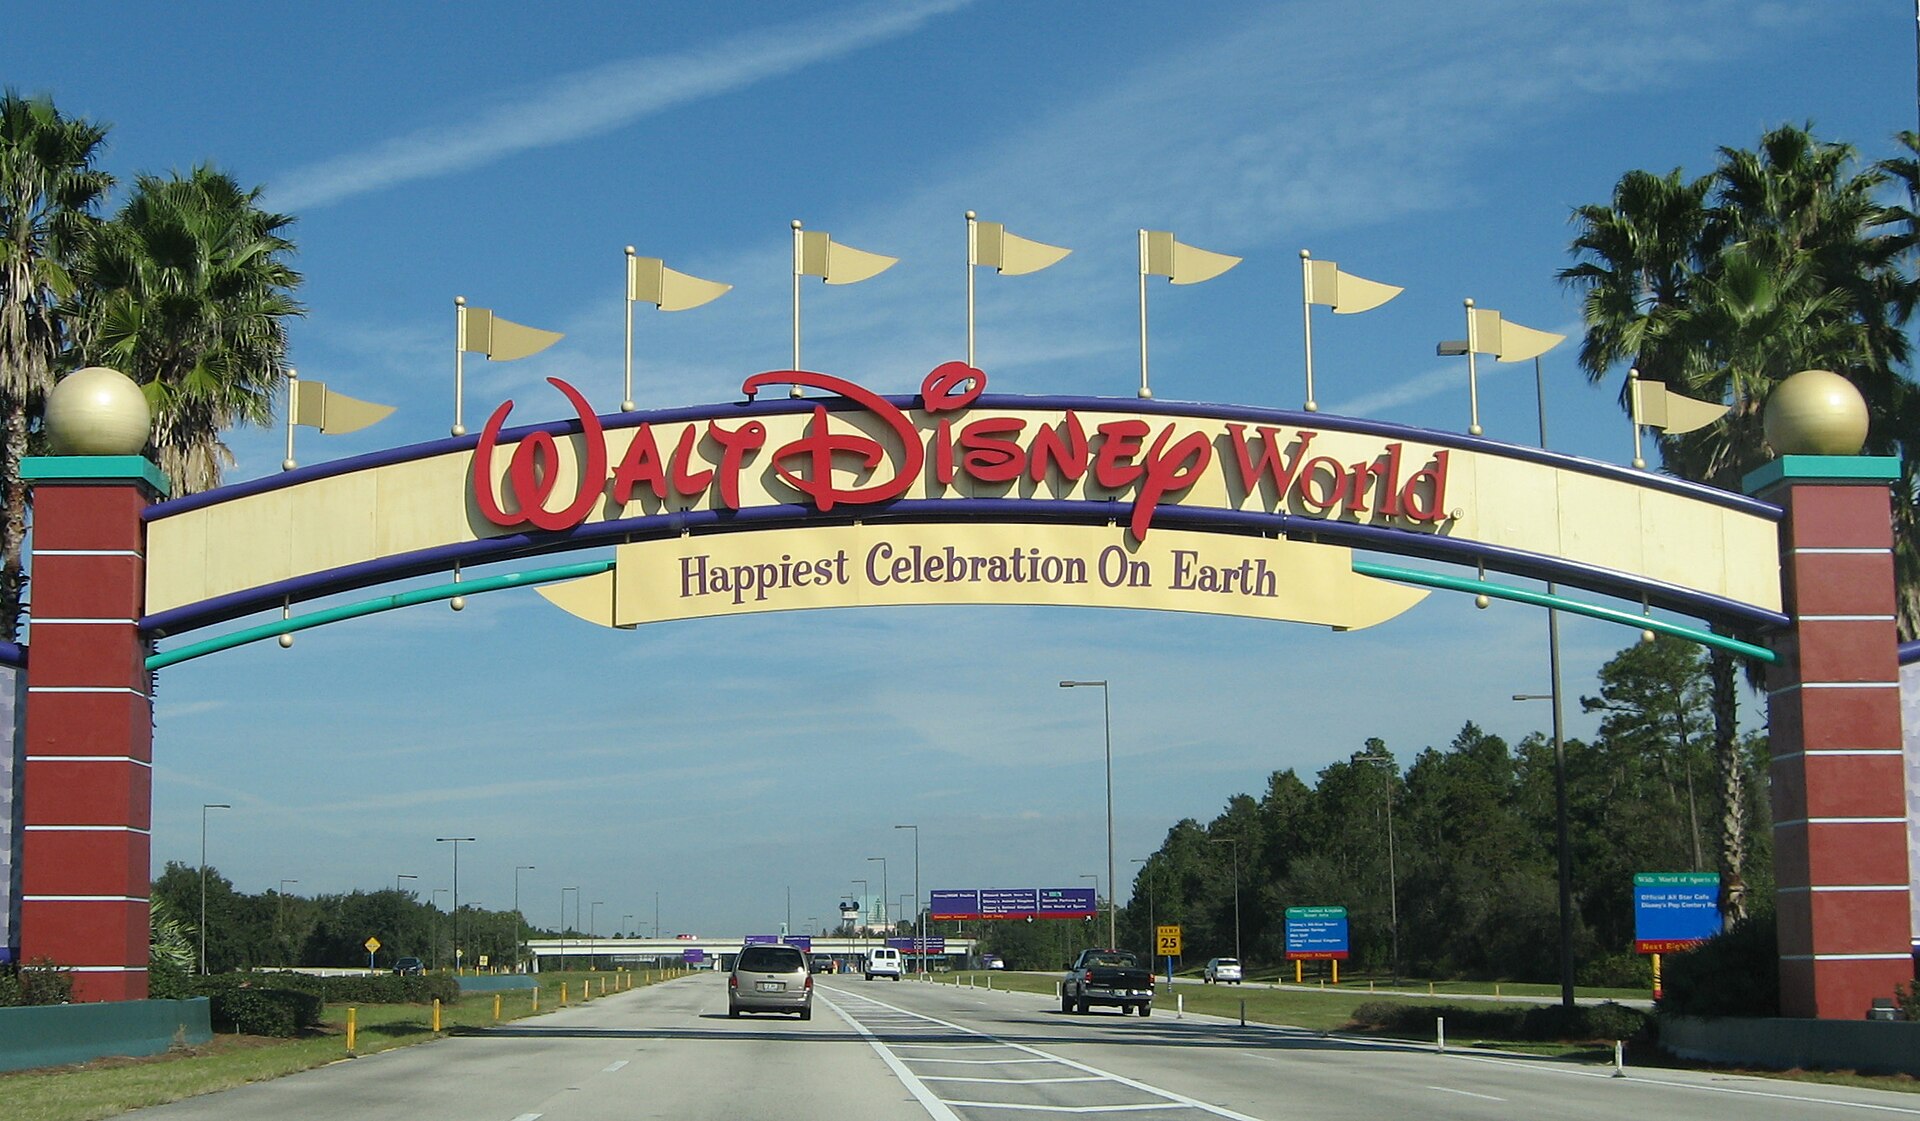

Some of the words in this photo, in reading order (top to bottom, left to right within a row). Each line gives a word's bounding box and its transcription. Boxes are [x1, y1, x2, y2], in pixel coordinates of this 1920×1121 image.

[1225, 423, 1449, 521] World
[678, 550, 850, 605] Happiest
[865, 541, 1088, 586] Celebration
[1098, 545, 1152, 588] On
[1168, 550, 1279, 597] Earth
[1161, 937, 1177, 948] 25
[1642, 942, 1662, 950] Next
